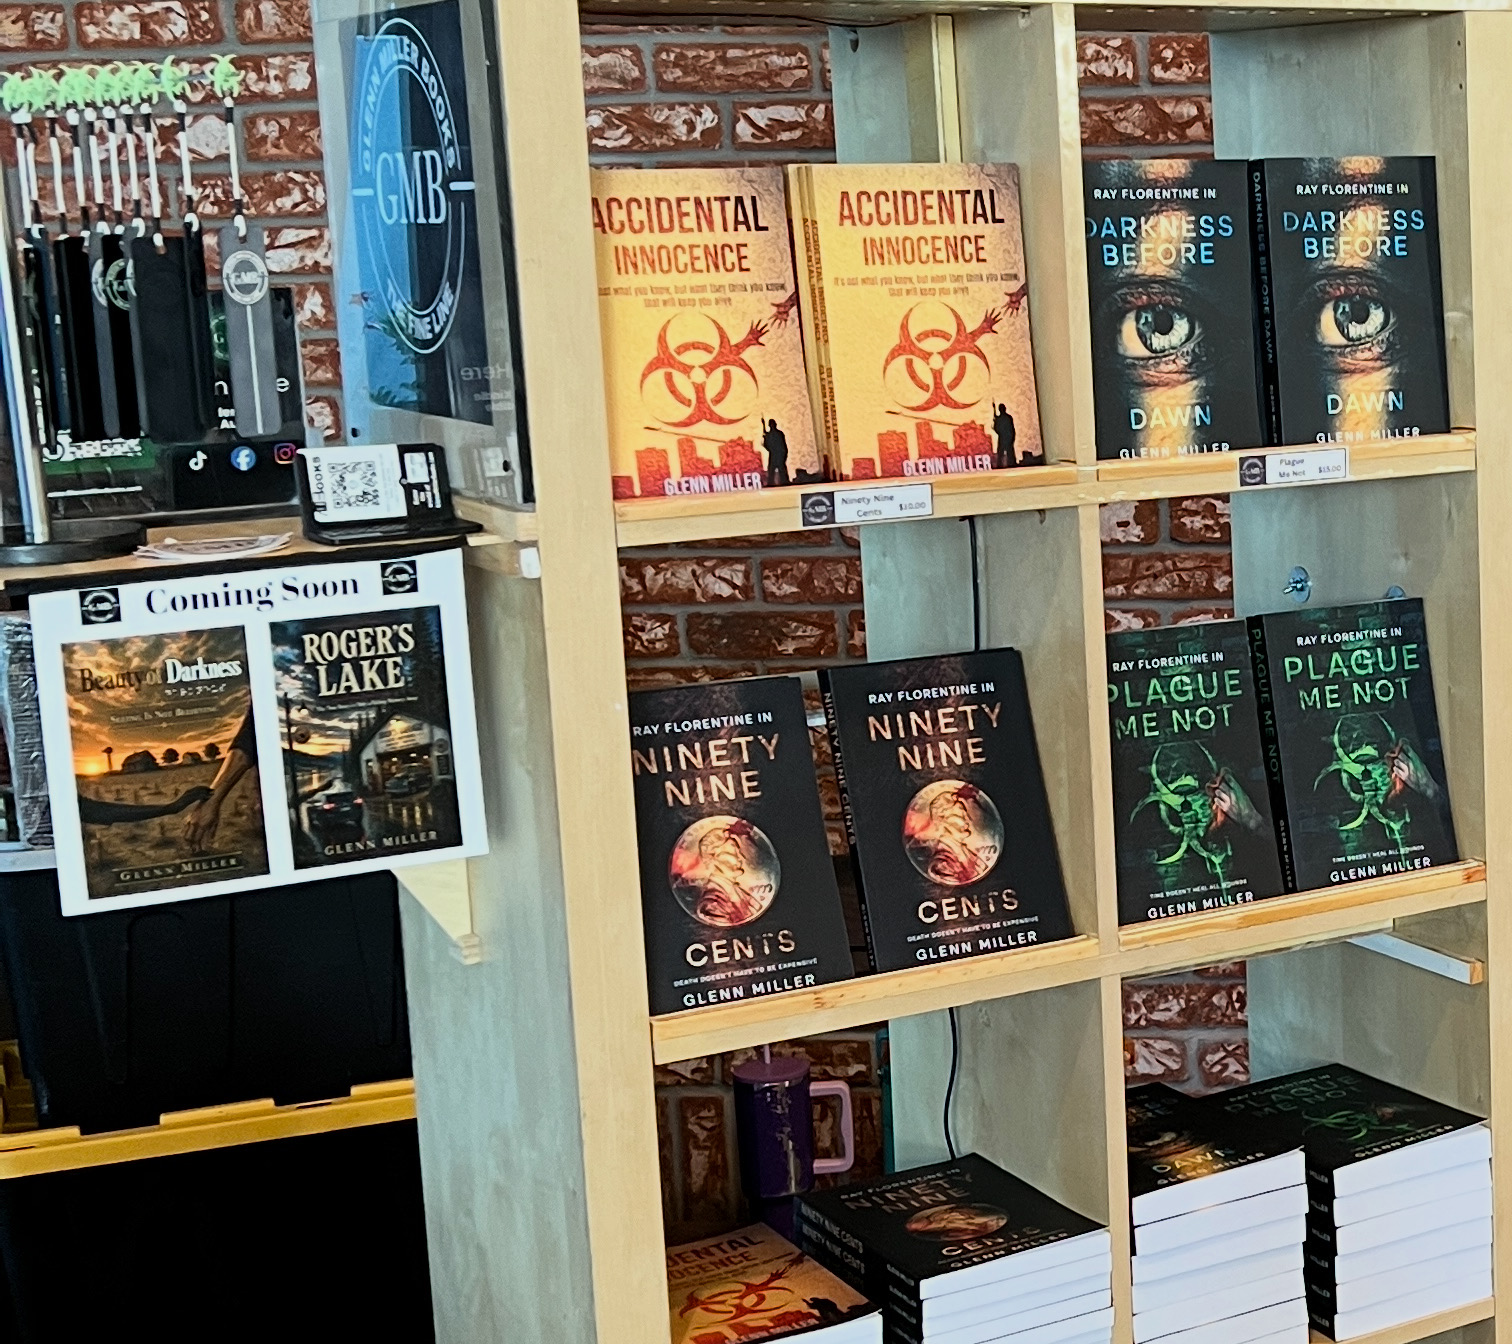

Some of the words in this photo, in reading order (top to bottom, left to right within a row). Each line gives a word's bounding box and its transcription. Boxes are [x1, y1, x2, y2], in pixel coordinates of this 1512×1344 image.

[421, 56, 455, 168] BOOKS
[376, 150, 448, 225] GMB
[1094, 188, 1118, 199] RAY
[1121, 188, 1199, 199] FLORENTINE
[1203, 188, 1216, 199] IN
[1296, 184, 1318, 195] RAY
[1321, 183, 1393, 196] FLORENTINE
[1396, 184, 1409, 195] IN
[838, 188, 1005, 227] ACCIDENTAL
[1282, 209, 1425, 232] DARKNESS
[613, 243, 751, 276] INNOCENCE
[863, 235, 987, 266] INNOCENCE
[1103, 242, 1215, 266] BEFORE
[1303, 236, 1408, 259] BEFORE
[1130, 405, 1212, 430] DAWN
[1326, 391, 1404, 416] DAWN
[1315, 431, 1364, 444] GLENN
[1370, 426, 1420, 440] MILLER
[902, 456, 946, 476] GLENN
[948, 454, 993, 473] MILLER
[1119, 446, 1170, 460] GLENN
[1177, 442, 1230, 455] MILLER
[1280, 458, 1304, 467] Plague
[664, 476, 711, 496] GLENN
[713, 472, 762, 493] MILLER
[841, 496, 871, 505] Ninety
[874, 494, 894, 502] Nine
[857, 509, 882, 517] Cents
[145, 581, 274, 616] Coming
[281, 576, 360, 601] Soon
[302, 623, 415, 664] ROGER'S
[1296, 635, 1318, 646] RAY
[1321, 629, 1387, 644] FLORENTINE
[1390, 627, 1402, 637] IN
[79, 668, 143, 692] Beauty
[146, 668, 162, 685] of
[165, 656, 242, 684] Darkness
[1112, 661, 1135, 672] RAY
[1138, 653, 1208, 670] FLORENTINE
[1211, 651, 1224, 662] IN
[1283, 643, 1421, 682] PLAGUE
[317, 657, 405, 697] LAKE
[868, 691, 893, 704] RAY
[897, 684, 977, 702] FLORENTINE
[981, 681, 995, 693] IN
[1299, 684, 1341, 711] ME
[1353, 676, 1411, 704] NOT
[633, 722, 659, 736] RAY
[664, 714, 752, 734] FLORENTINE
[757, 711, 773, 725] IN
[867, 702, 1002, 742] NINETY
[1115, 712, 1160, 740] ME
[1172, 703, 1234, 733] NOT
[633, 733, 780, 775] NINETY
[897, 737, 987, 772] NINE
[664, 770, 762, 807] NINE
[324, 840, 375, 856] GLENN
[382, 830, 437, 847] MILLER
[1330, 866, 1377, 883] GLENN
[1382, 856, 1432, 875] MILLER
[918, 888, 1018, 924] CENTS
[1148, 901, 1197, 919] GLENN
[1203, 891, 1254, 910] MILLER
[686, 929, 796, 967] CENTS
[915, 941, 972, 961] GLENN
[978, 930, 1037, 951] MILLER
[683, 985, 744, 1007] GLENN
[752, 974, 816, 995] MILLER
